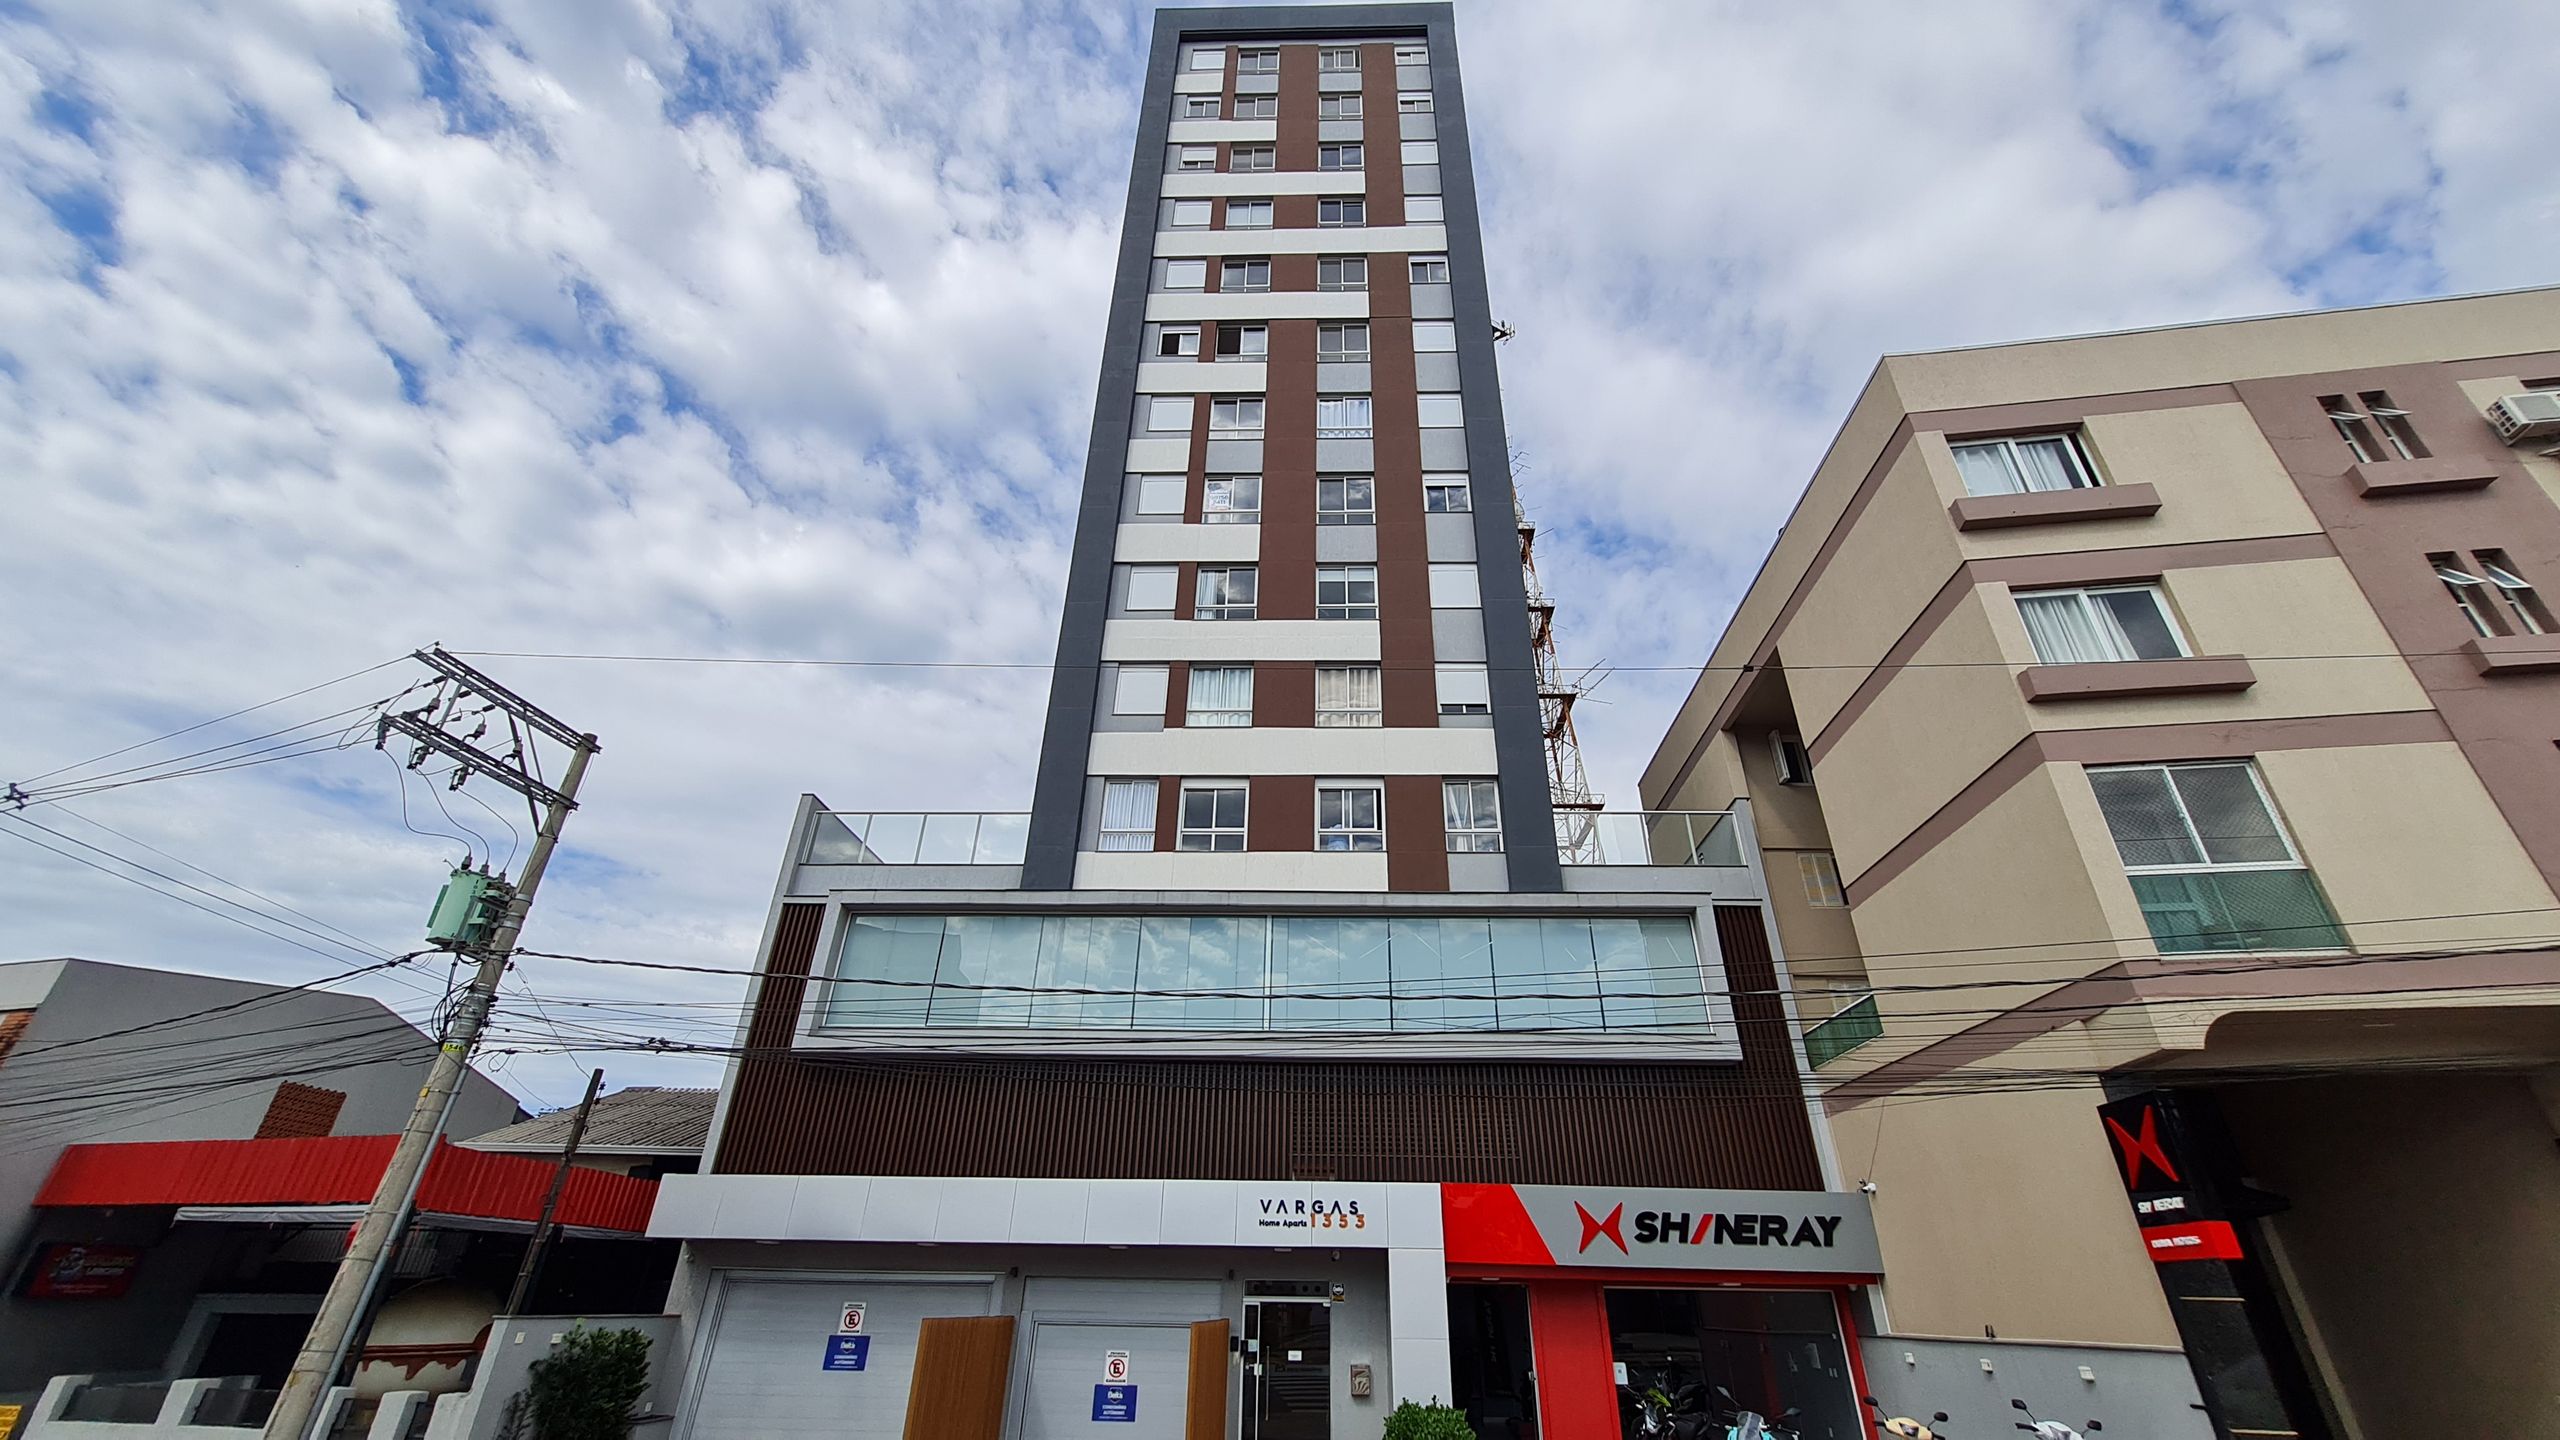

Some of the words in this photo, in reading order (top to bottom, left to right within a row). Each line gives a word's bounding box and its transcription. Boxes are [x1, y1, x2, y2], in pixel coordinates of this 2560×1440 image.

[1260, 1199, 1359, 1215] VARGAS
[1259, 1219, 1280, 1227] Home
[1283, 1219, 1307, 1228] Aparts
[1310, 1213, 1365, 1229] 1353
[1634, 1211, 1842, 1247] SHINERAY
